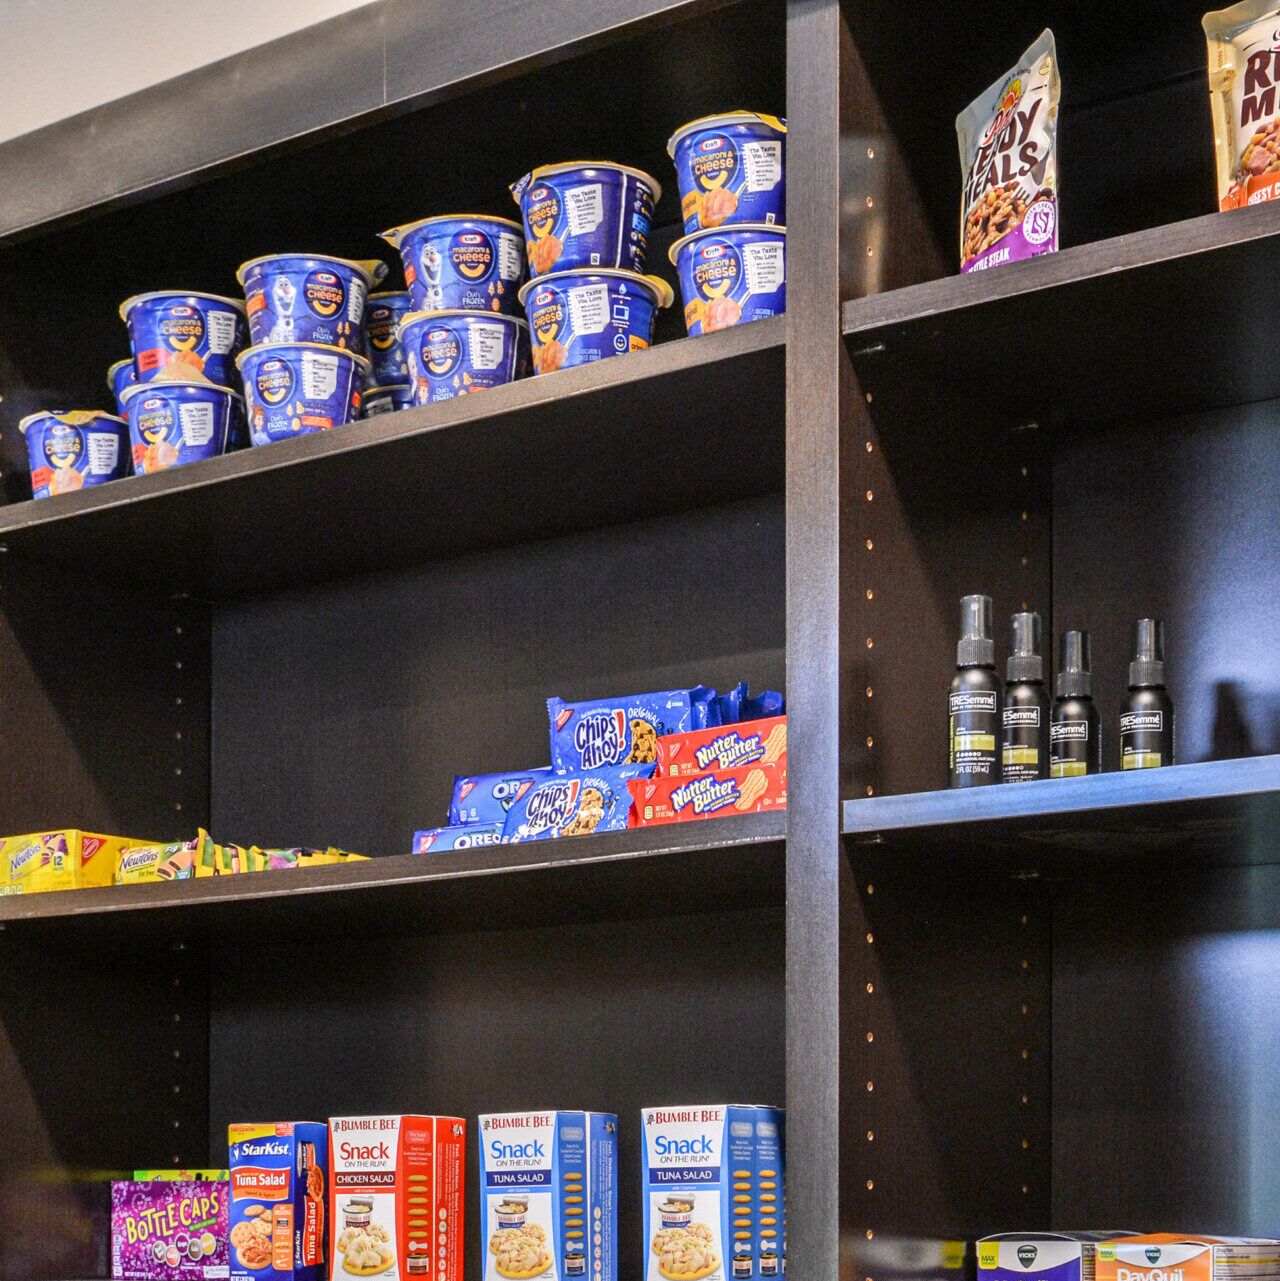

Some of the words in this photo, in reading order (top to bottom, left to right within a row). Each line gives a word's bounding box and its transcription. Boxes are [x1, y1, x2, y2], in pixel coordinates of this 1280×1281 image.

[704, 140, 719, 149] Kraft
[694, 152, 726, 165] macaroni
[696, 260, 728, 272] macaroni
[988, 248, 1010, 267] STEAK
[951, 695, 994, 705] TRESemmé
[628, 708, 659, 726] ORIGINAL
[577, 716, 616, 749] Chips
[696, 734, 737, 769] Nutter
[719, 736, 759, 769] Butter
[492, 782, 520, 799] OR
[671, 776, 713, 810] Nutter
[694, 781, 735, 813] Butter
[528, 785, 569, 818] Chips
[454, 833, 501, 850] OREO
[11, 844, 40, 871] Newtons
[54, 856, 62, 865] 12
[122, 851, 159, 869] Newtons
[341, 1120, 378, 1131] BUMBLE
[380, 1119, 396, 1131] BEE
[491, 1117, 531, 1129] BUMBLE
[534, 1116, 551, 1127] BEE
[656, 1112, 698, 1124] BUMBLE
[702, 1111, 719, 1122] BEE
[242, 1144, 289, 1155] StarKist
[340, 1142, 390, 1160] Snack
[491, 1140, 545, 1159] Snack
[655, 1135, 713, 1155] Snack
[235, 1174, 257, 1186] Tuna
[259, 1174, 286, 1186] Salad
[336, 1175, 368, 1183] CHICKEN
[370, 1174, 394, 1183] SALAD
[493, 1175, 515, 1183] TUNA
[518, 1174, 544, 1182] SALAD
[657, 1172, 681, 1180] TUNA
[684, 1171, 712, 1179] SALAD
[126, 1204, 178, 1244] BOTTLE
[180, 1192, 219, 1226] CAPS
